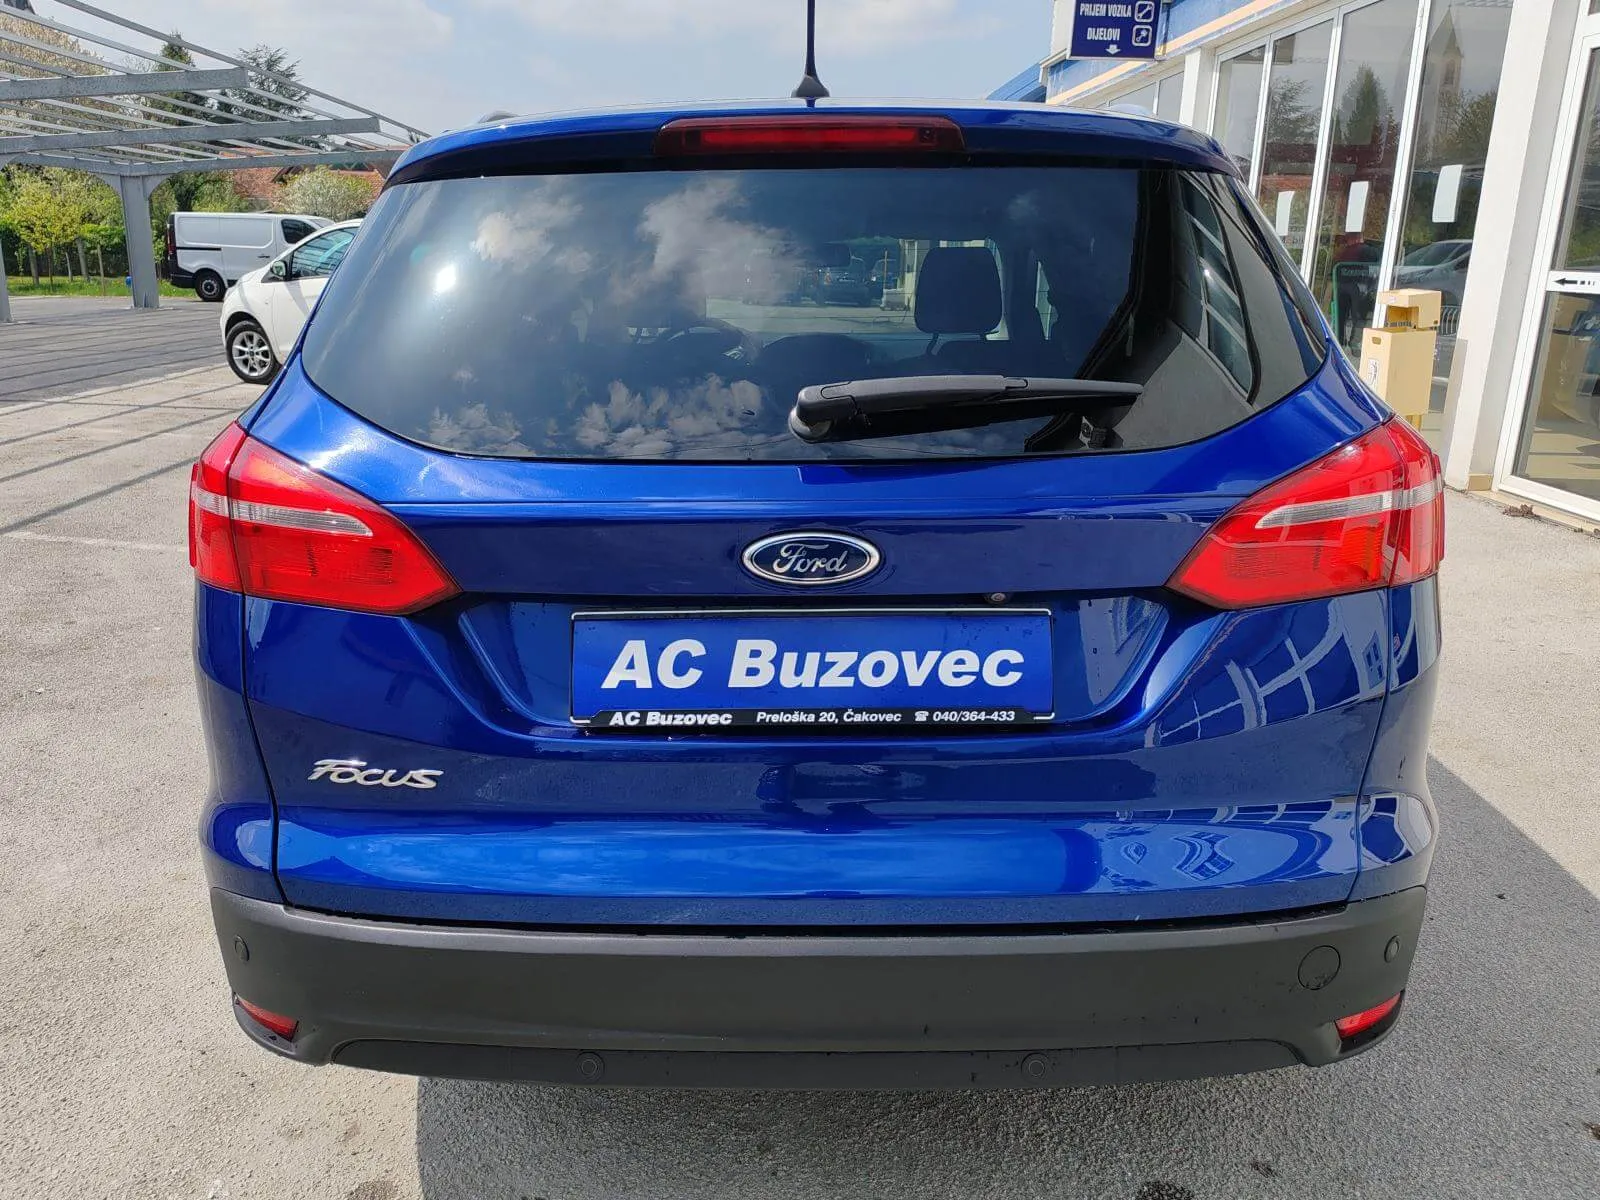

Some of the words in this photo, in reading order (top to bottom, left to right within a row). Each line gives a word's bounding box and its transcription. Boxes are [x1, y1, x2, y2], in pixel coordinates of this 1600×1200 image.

[1079, 3, 1106, 17] PRIJEM
[1108, 4, 1132, 17] VOZILA
[1086, 27, 1120, 40] DIJELOVI
[772, 543, 848, 573] Ford
[601, 638, 707, 689] AC
[728, 639, 1025, 688] Buzovec
[609, 711, 641, 726] AC
[646, 710, 733, 725] Buzovec
[756, 710, 815, 723] Preloška
[818, 711, 839, 724] 20,
[843, 708, 902, 722] Čakovec
[932, 710, 1016, 722] 040/364-433
